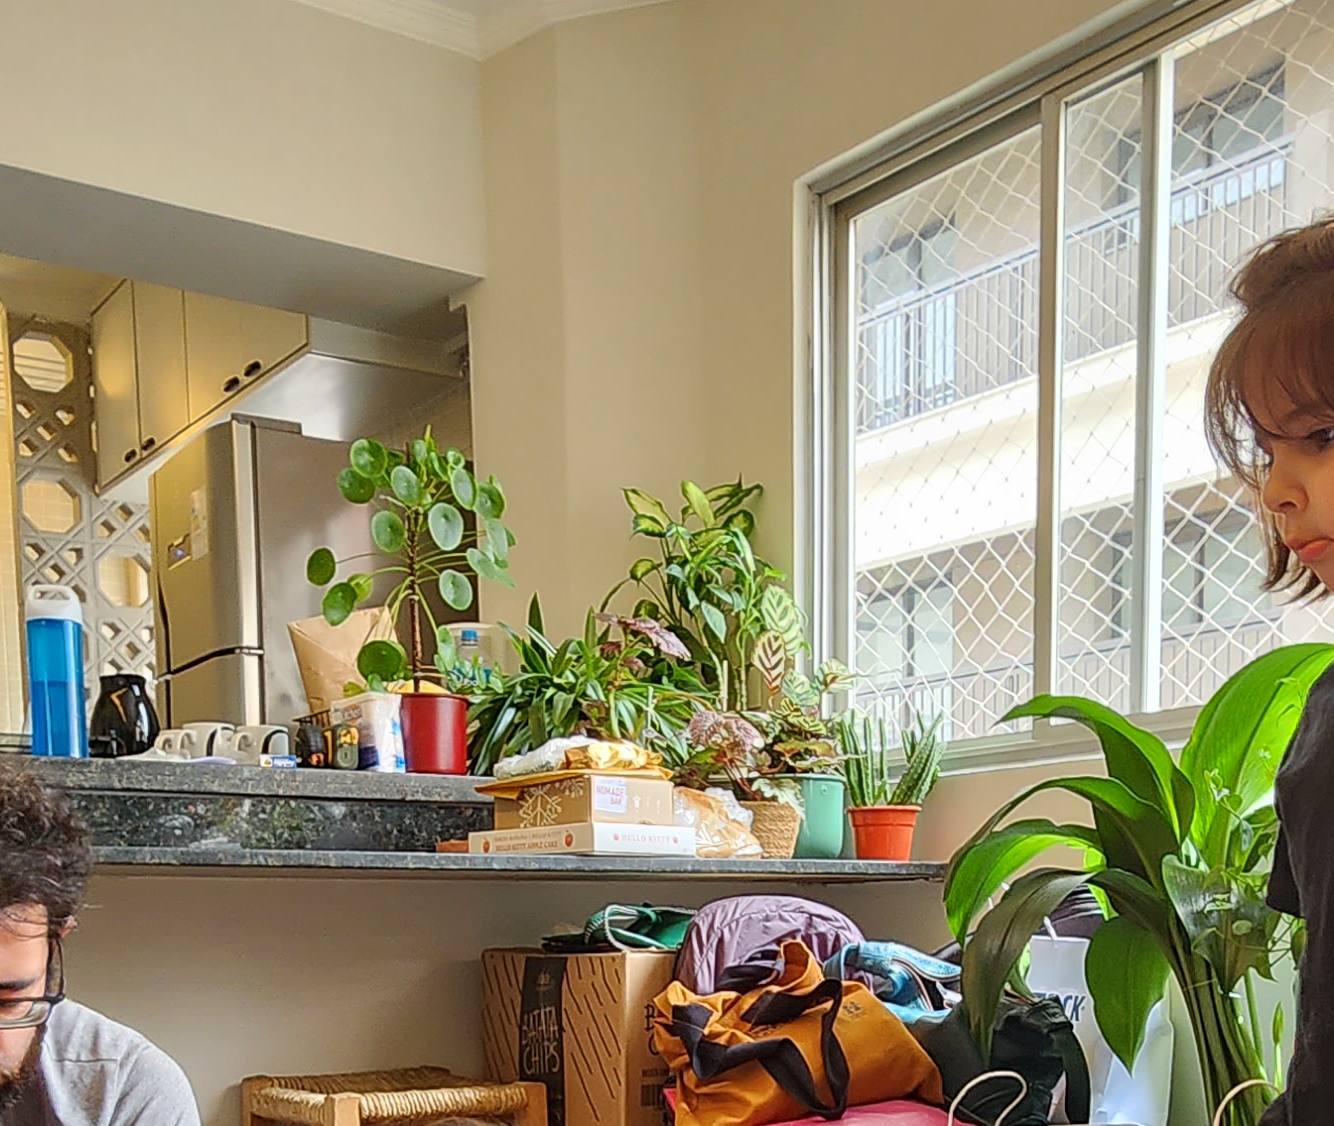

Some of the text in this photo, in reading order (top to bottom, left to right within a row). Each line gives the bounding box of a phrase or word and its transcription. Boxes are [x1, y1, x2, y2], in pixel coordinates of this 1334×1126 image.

[621, 834, 670, 845] HELLO KITTY
[522, 1005, 560, 1045] BATATA
[523, 1042, 560, 1075] CHIPS
